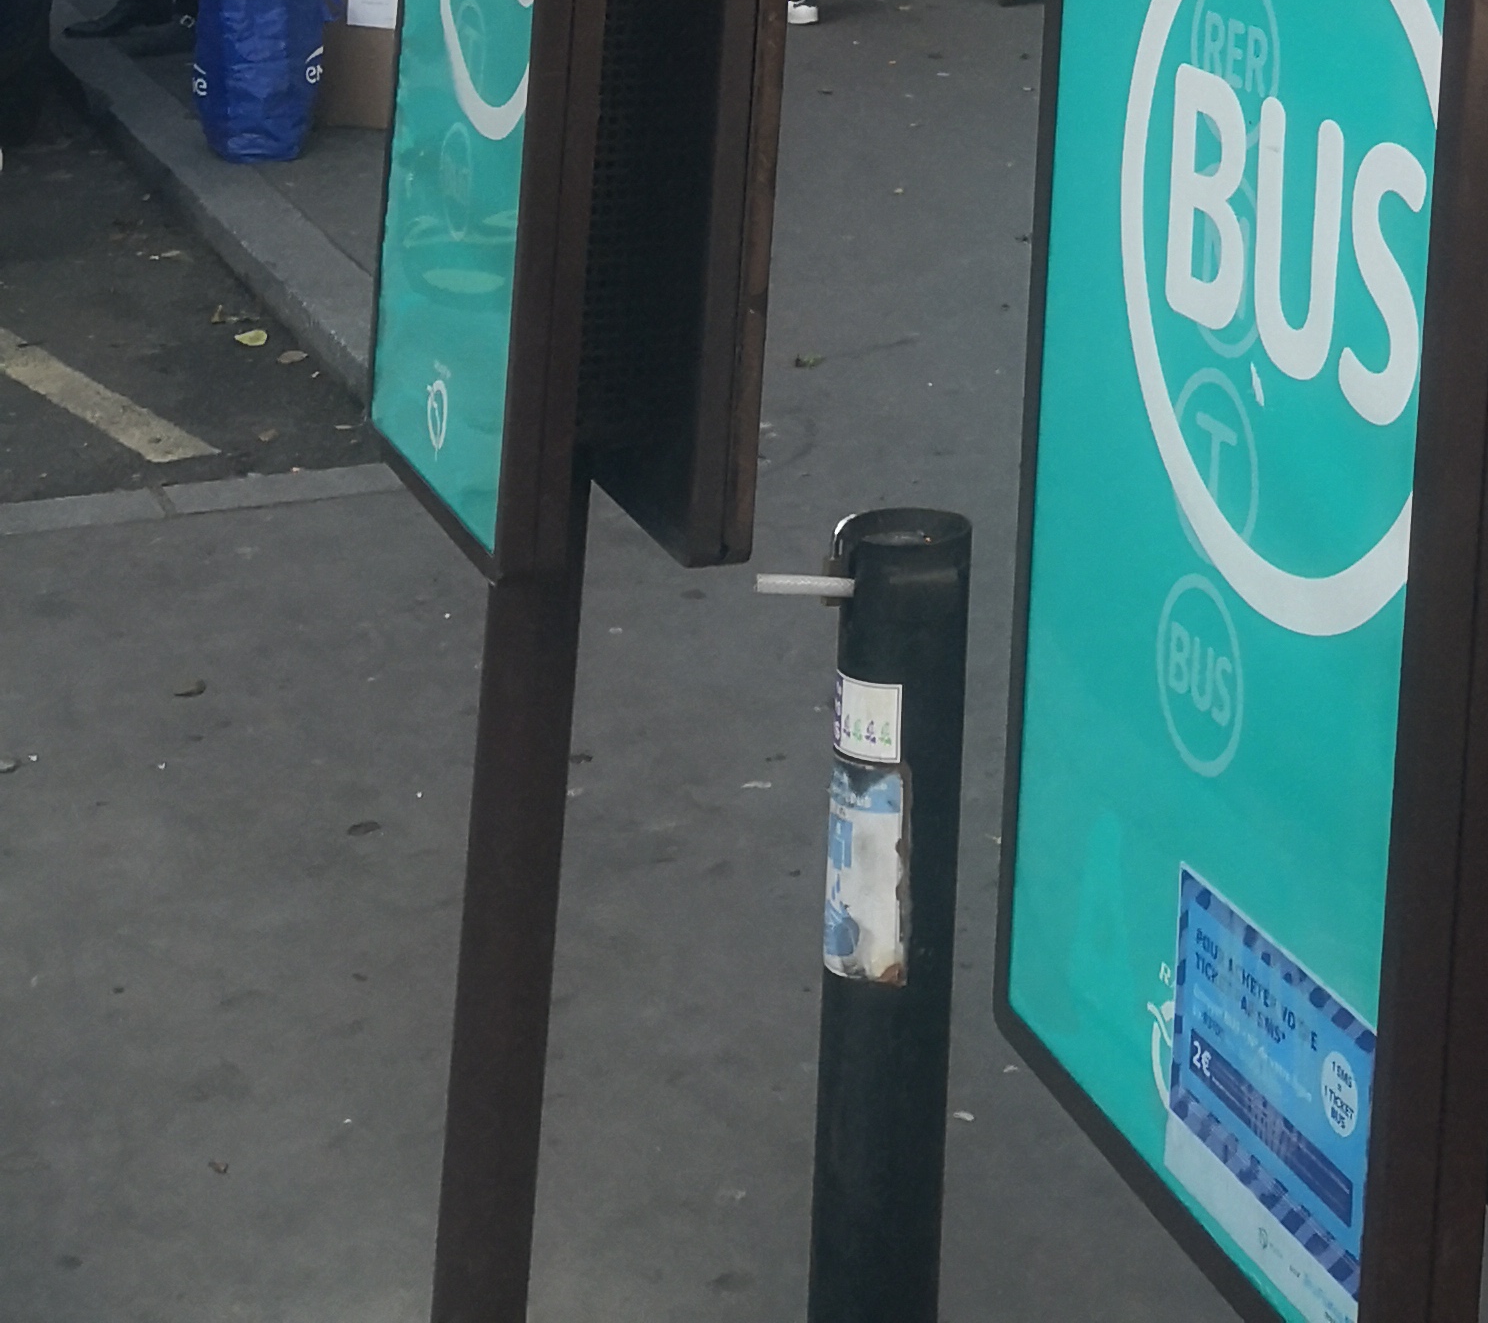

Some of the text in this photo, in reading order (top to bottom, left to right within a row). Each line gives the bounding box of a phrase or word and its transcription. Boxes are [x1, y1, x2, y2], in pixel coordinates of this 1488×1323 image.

[1202, 10, 1269, 98] RER
[1165, 62, 1427, 426] BUS
[1168, 621, 1233, 728] BUS
[1192, 1039, 1212, 1078] 2€
